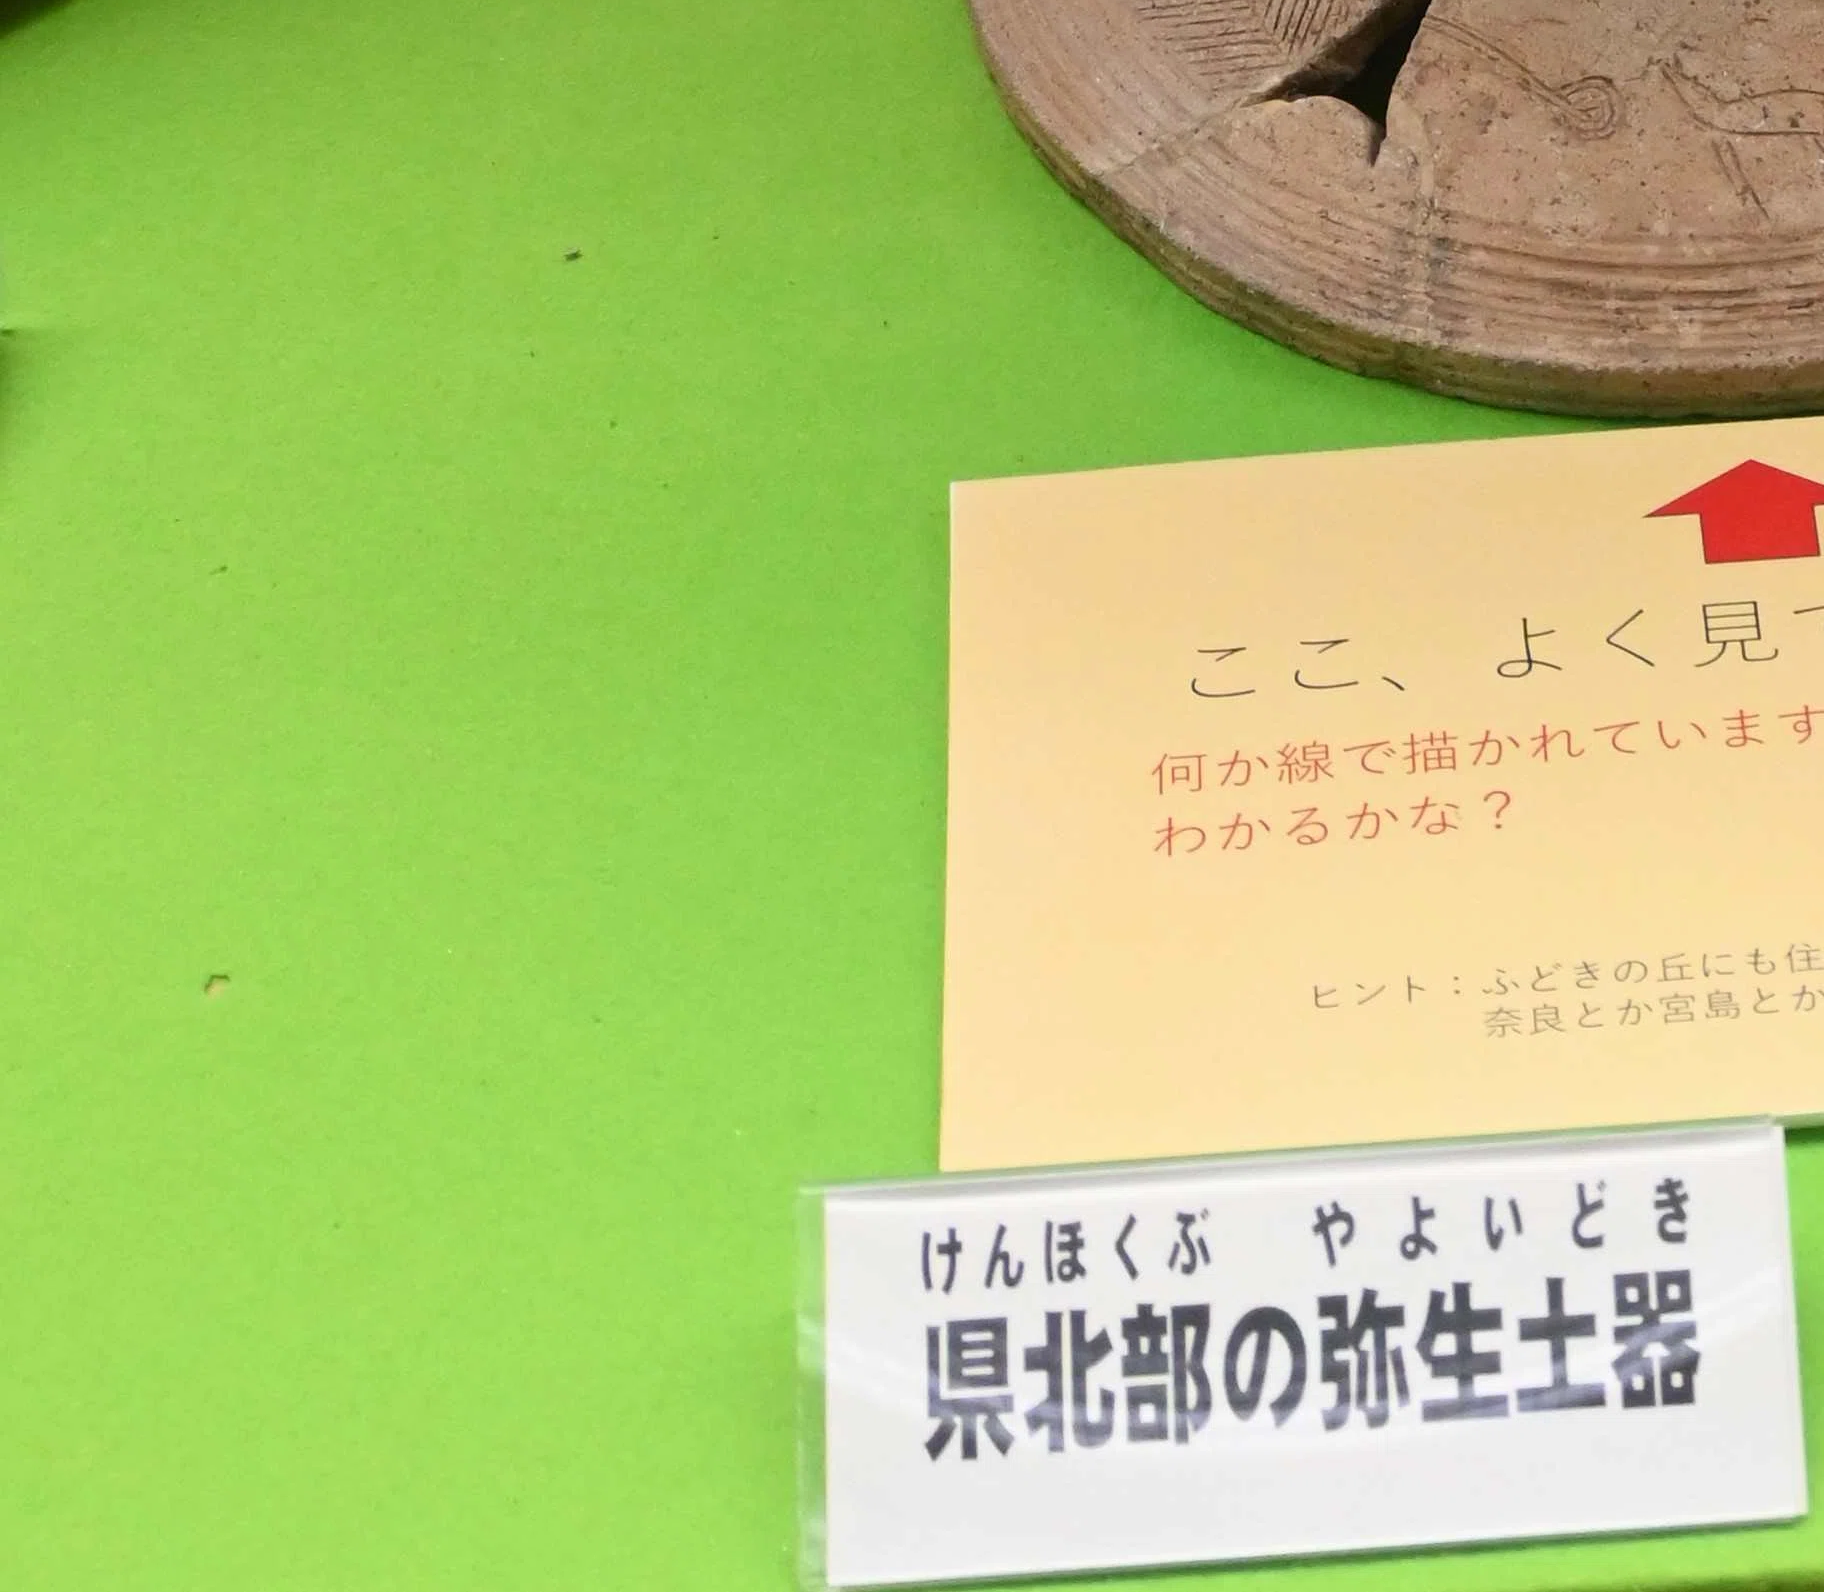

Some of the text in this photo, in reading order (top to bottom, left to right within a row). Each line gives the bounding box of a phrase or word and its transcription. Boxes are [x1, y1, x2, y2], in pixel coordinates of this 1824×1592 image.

[921, 1176, 1692, 1294] けんほくぶ やよいどき
[923, 1268, 1702, 1461] 県北部の弥生土器
